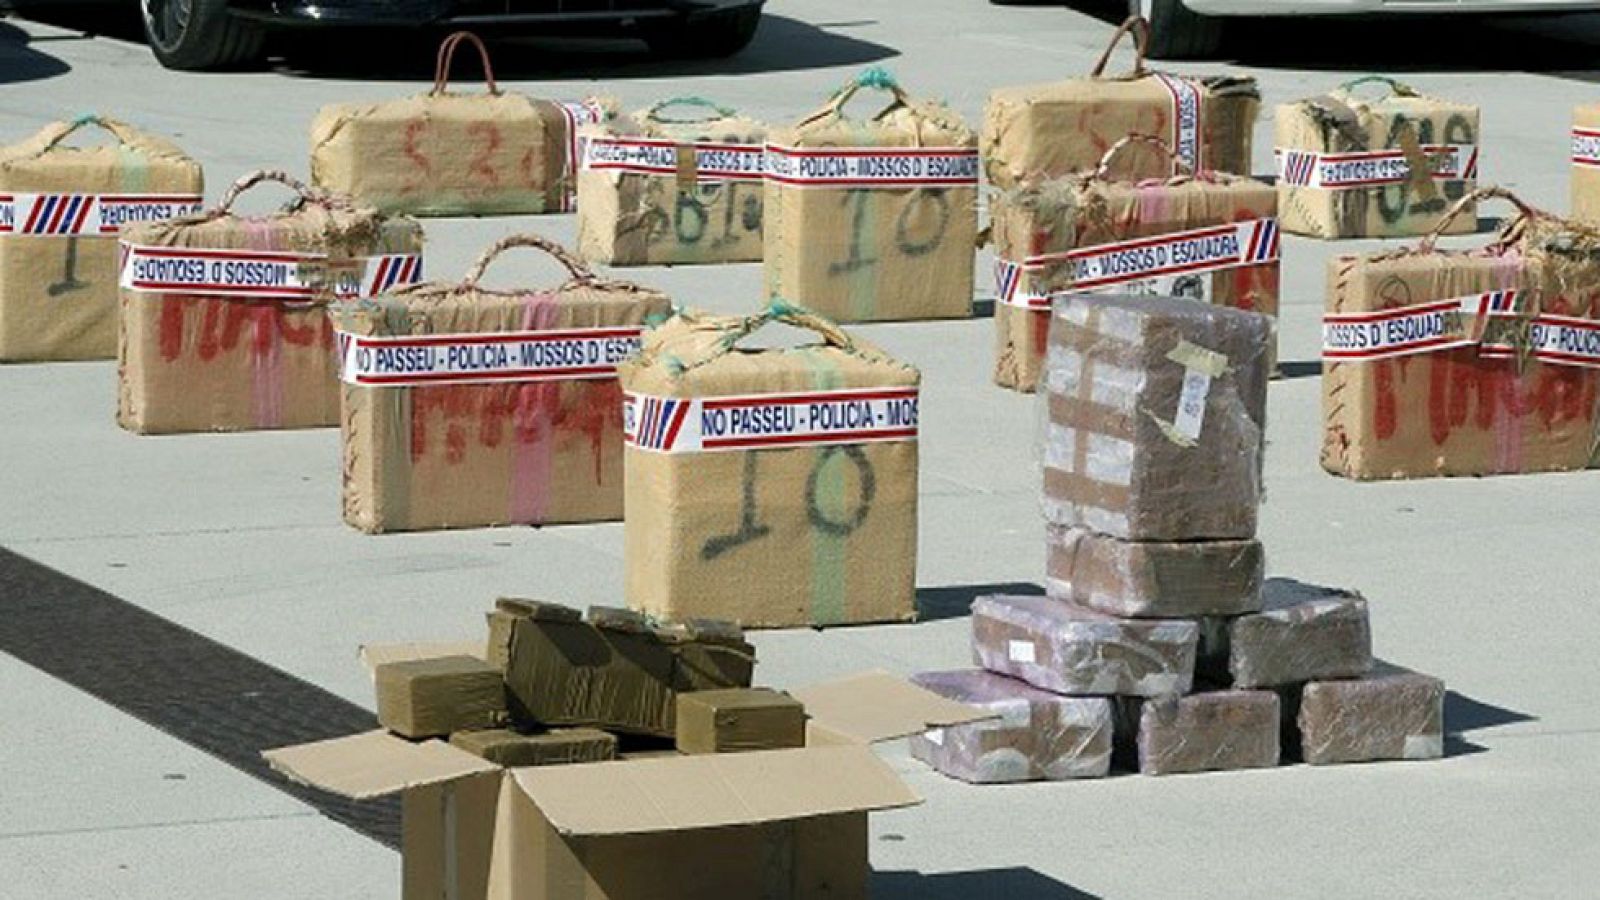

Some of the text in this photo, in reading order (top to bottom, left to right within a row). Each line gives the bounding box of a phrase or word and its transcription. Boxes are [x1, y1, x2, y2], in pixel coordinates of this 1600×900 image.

[800, 157, 848, 177] POLICIA
[858, 157, 911, 177] MOSSOS
[225, 262, 287, 285] MOSSOS
[1100, 248, 1155, 276] MOSSOS
[376, 346, 435, 372] PASSEU
[449, 344, 507, 371] POLICIA
[520, 340, 584, 367] MOSSOS
[702, 408, 726, 437] NO
[731, 405, 795, 435] PASSEU
[809, 402, 874, 431] POLICIA
